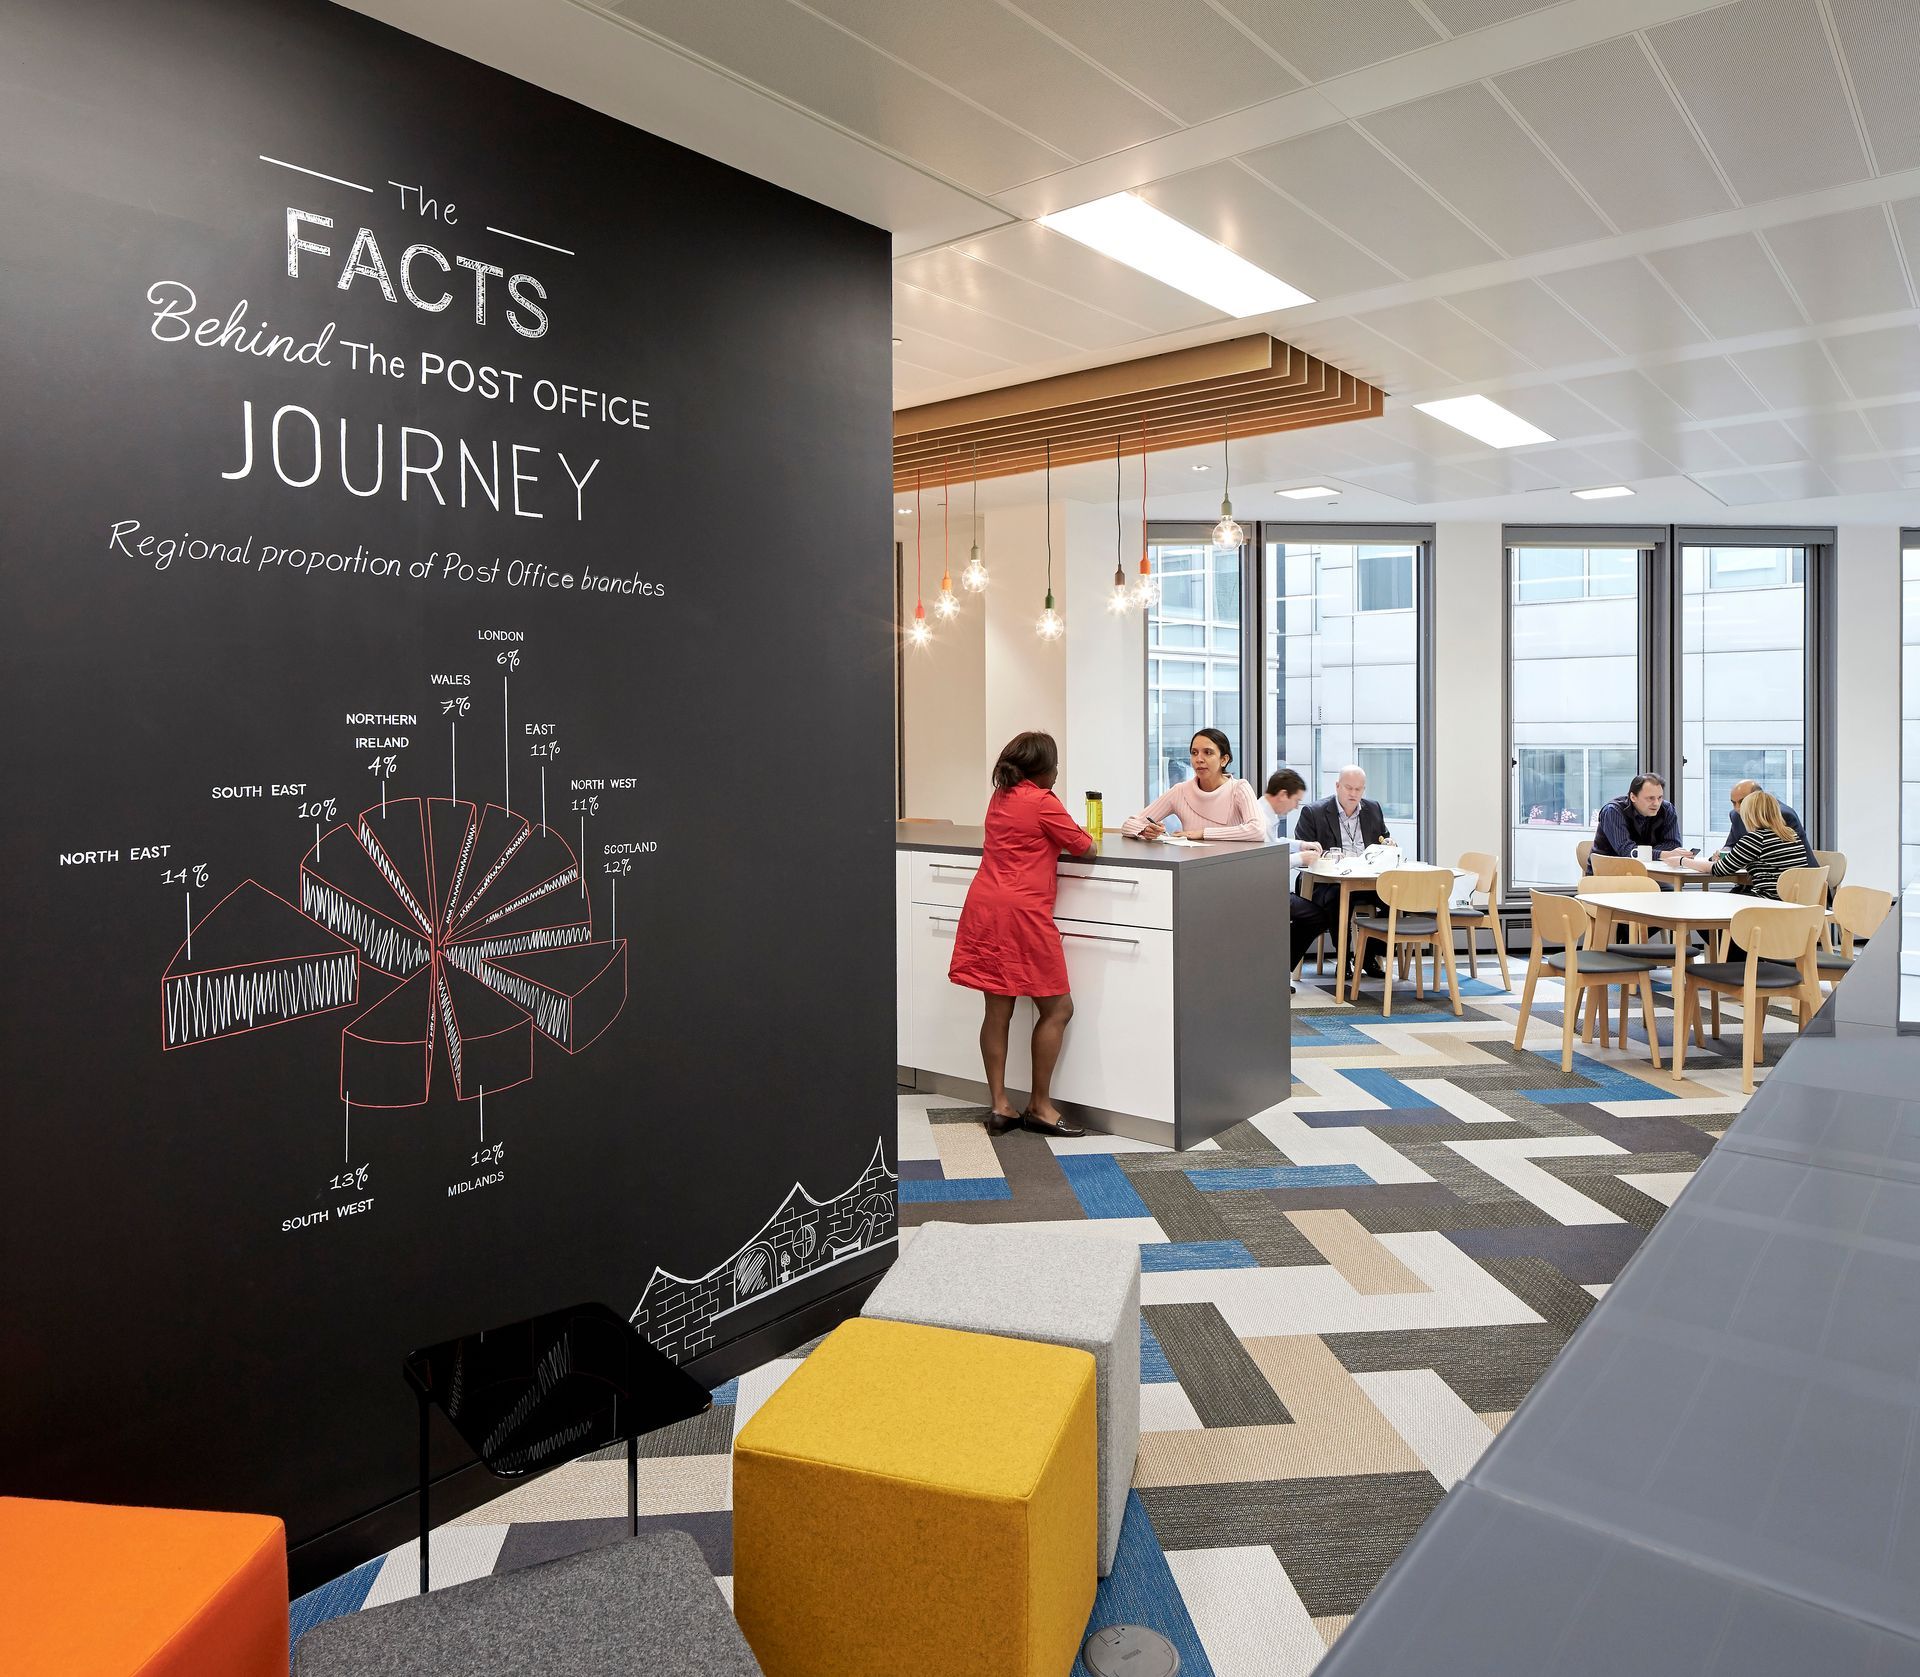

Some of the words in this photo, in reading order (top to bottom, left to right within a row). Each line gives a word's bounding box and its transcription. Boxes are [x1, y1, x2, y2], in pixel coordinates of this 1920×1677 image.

[387, 180, 458, 225] The
[286, 206, 549, 339] FACTS
[146, 280, 336, 367] Behind
[339, 340, 405, 379] The
[421, 351, 523, 404] POST
[533, 379, 651, 430] OFFICE
[221, 400, 601, 522] JOURNEY
[108, 519, 253, 571] Regional
[257, 544, 401, 577] proportion
[408, 551, 439, 579] of
[442, 552, 501, 584] Post
[507, 559, 574, 589] Office
[580, 565, 665, 597] branches
[477, 629, 524, 642] LONDON
[496, 648, 521, 673] 6%
[430, 673, 471, 686] WALES
[439, 695, 471, 718] 7%
[345, 712, 417, 726] NORTHERN
[525, 723, 556, 736] EAST
[355, 736, 410, 749] IRELAND
[530, 739, 561, 762] 11%
[367, 754, 397, 779] 4%
[211, 785, 263, 799] SOUTH
[271, 783, 307, 797] EAST
[570, 779, 605, 791] NORTH
[609, 777, 638, 789] WEST
[297, 797, 337, 822] 10%
[571, 794, 600, 817] 11%
[59, 849, 119, 866] NORTH
[130, 844, 172, 861] EAST
[603, 841, 658, 855] SCOTLAND
[160, 862, 210, 889] 14%
[603, 857, 632, 877] 12%
[470, 1141, 505, 1167] 12%
[329, 1162, 370, 1191] 13%
[447, 1170, 505, 1198] MIDLANDS
[281, 1209, 329, 1232] SOUTH
[336, 1197, 375, 1218] WEST
